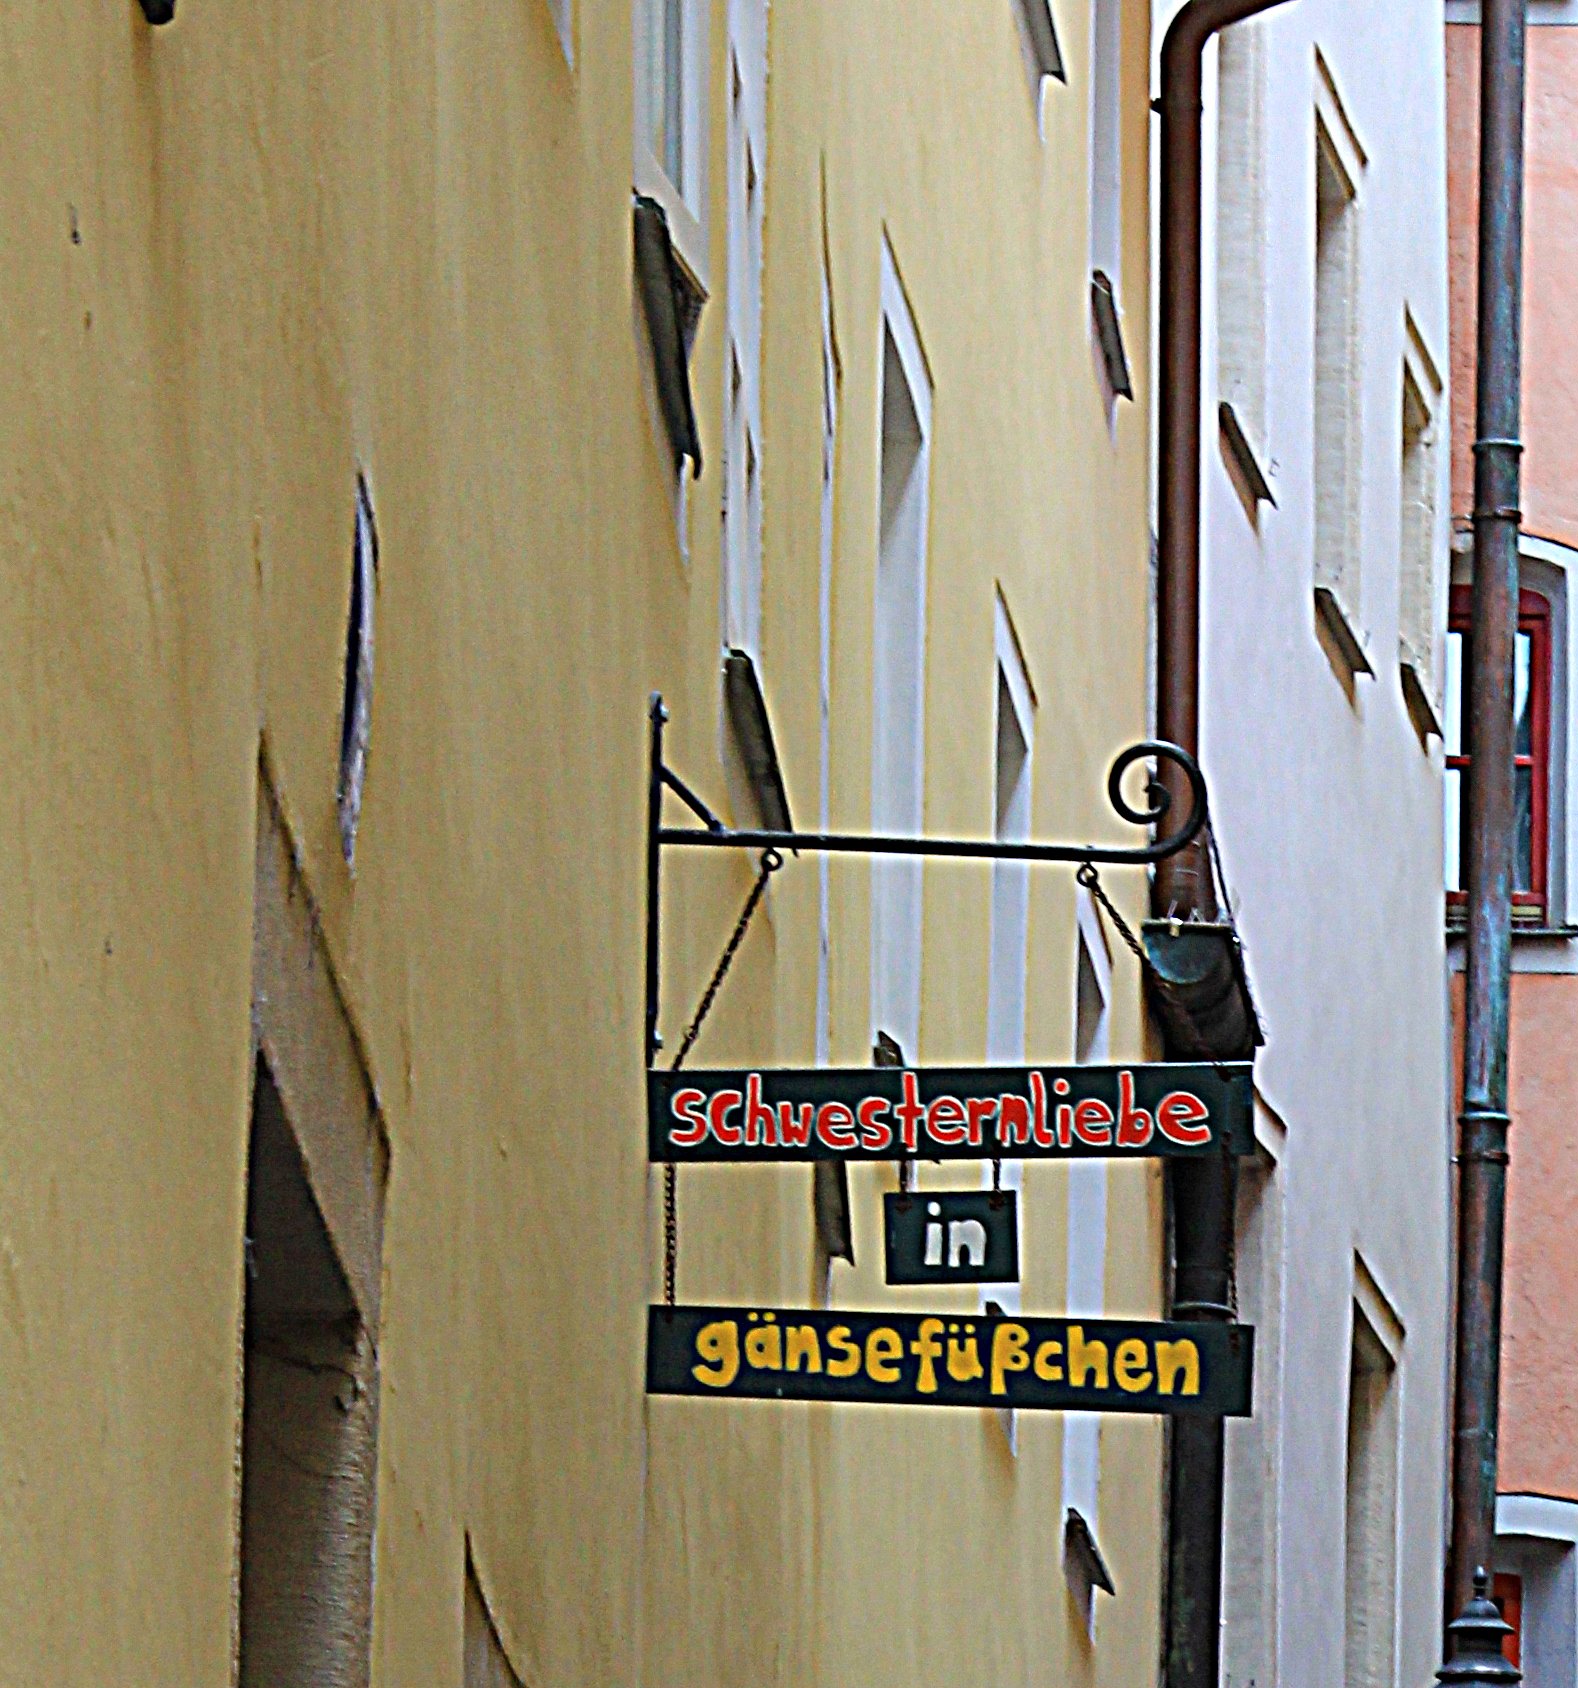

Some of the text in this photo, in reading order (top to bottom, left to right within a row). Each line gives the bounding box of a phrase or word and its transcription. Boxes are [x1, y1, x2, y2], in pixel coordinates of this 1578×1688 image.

[668, 1070, 1211, 1151] schwesternliebe
[922, 1201, 988, 1268] in
[691, 1313, 1201, 1396] gänsefüßchen
